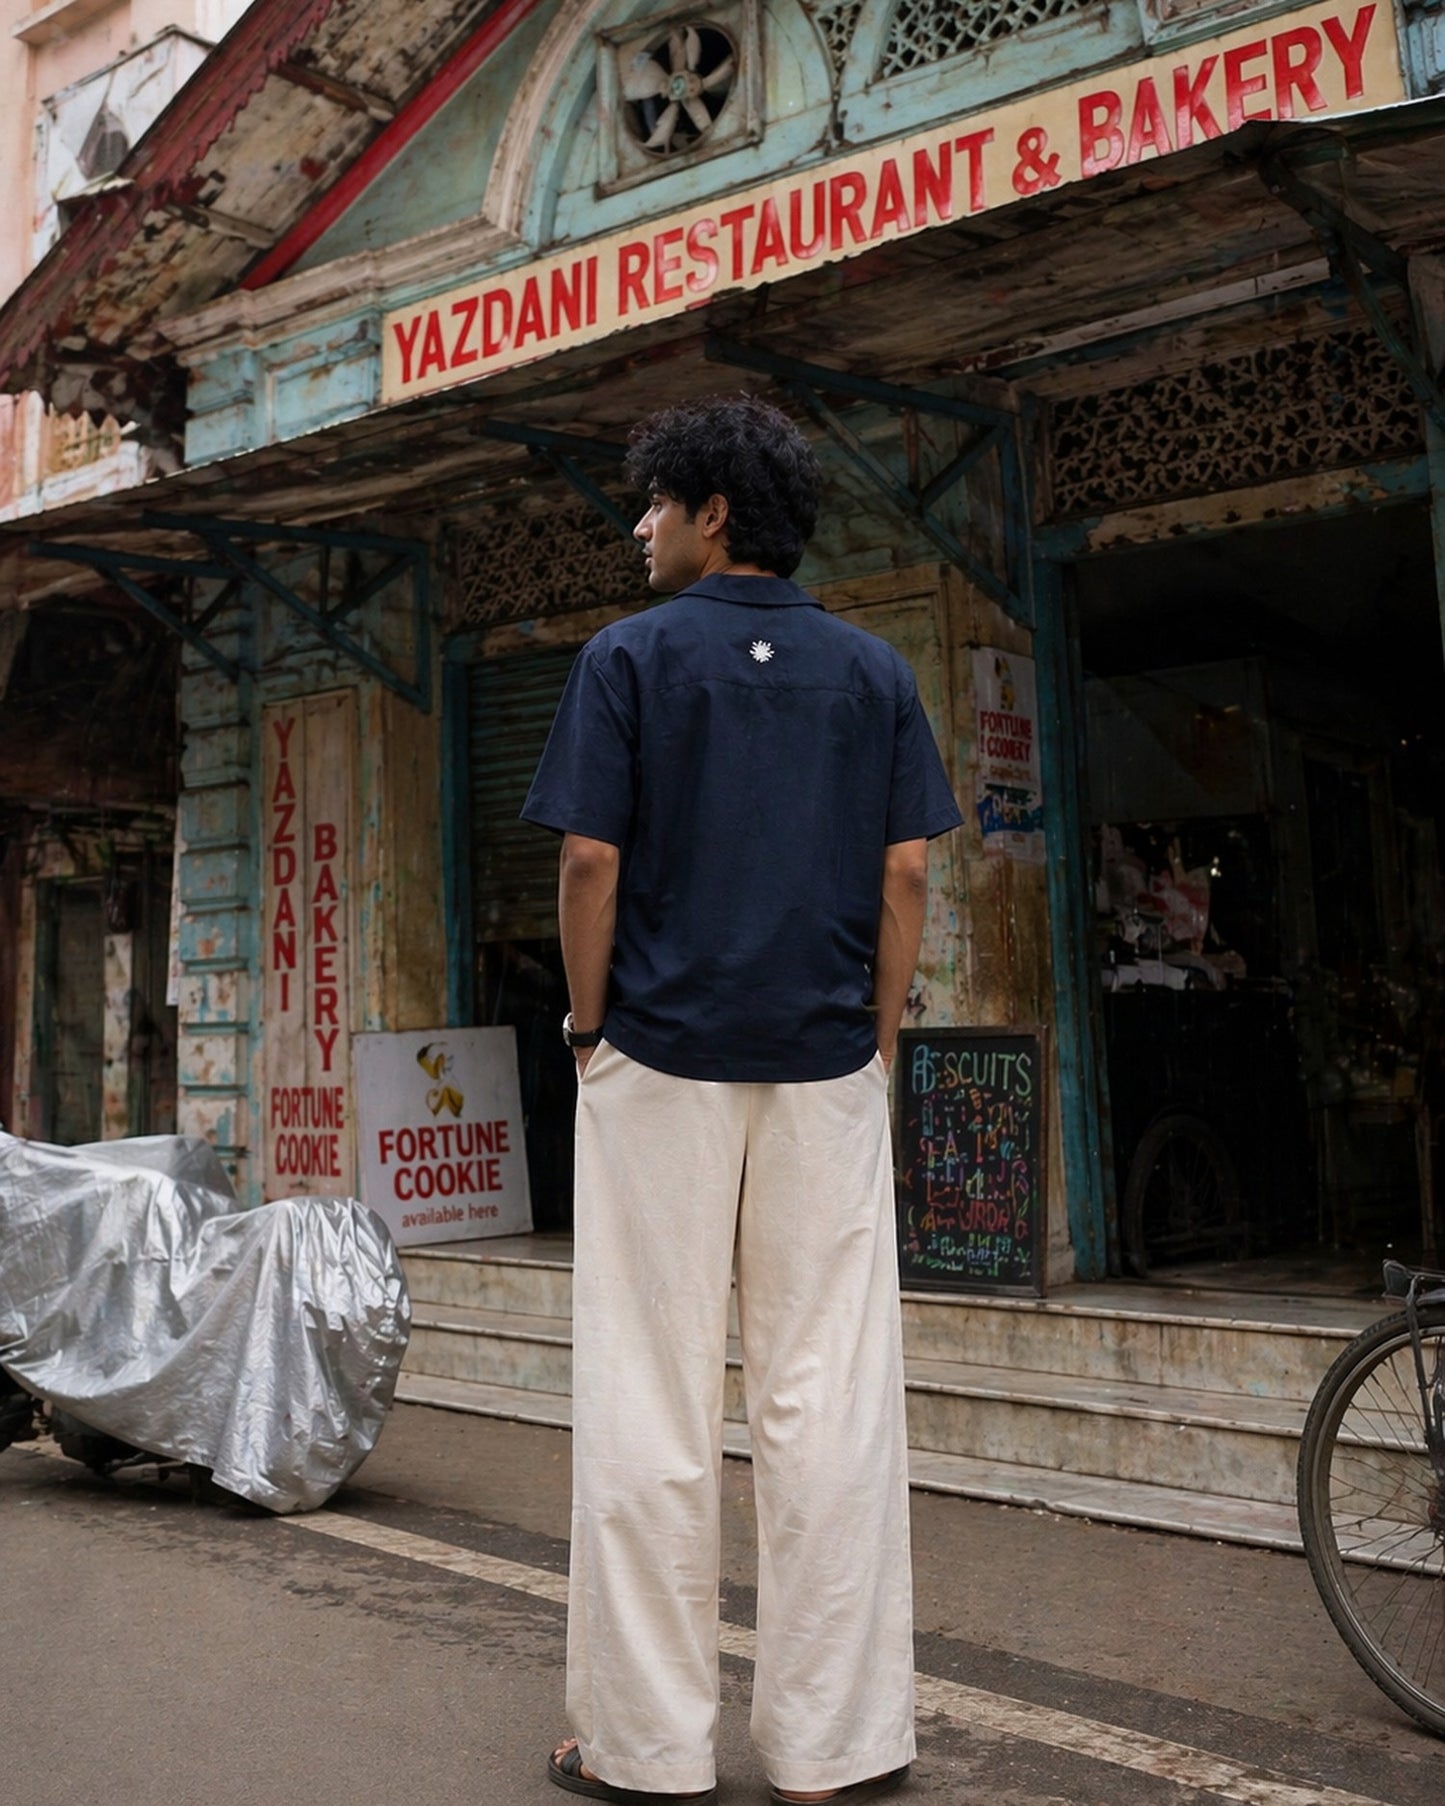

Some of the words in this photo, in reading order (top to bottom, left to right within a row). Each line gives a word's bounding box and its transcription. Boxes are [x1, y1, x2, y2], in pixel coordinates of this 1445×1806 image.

[393, 256, 598, 384] YAZDANI
[618, 127, 994, 316] RESTAURANT
[1012, 127, 1061, 196] &
[1078, 3, 1377, 180] BAKERY
[273, 717, 296, 1013] YAZDANI
[313, 823, 340, 1072] BAKERY
[271, 1086, 344, 1130] FORTUNE
[275, 1133, 342, 1177] COOKIE
[378, 1120, 511, 1164] FORTUNE
[393, 1158, 503, 1201] COOKIE
[402, 1206, 464, 1228] available
[468, 1203, 499, 1220] here
